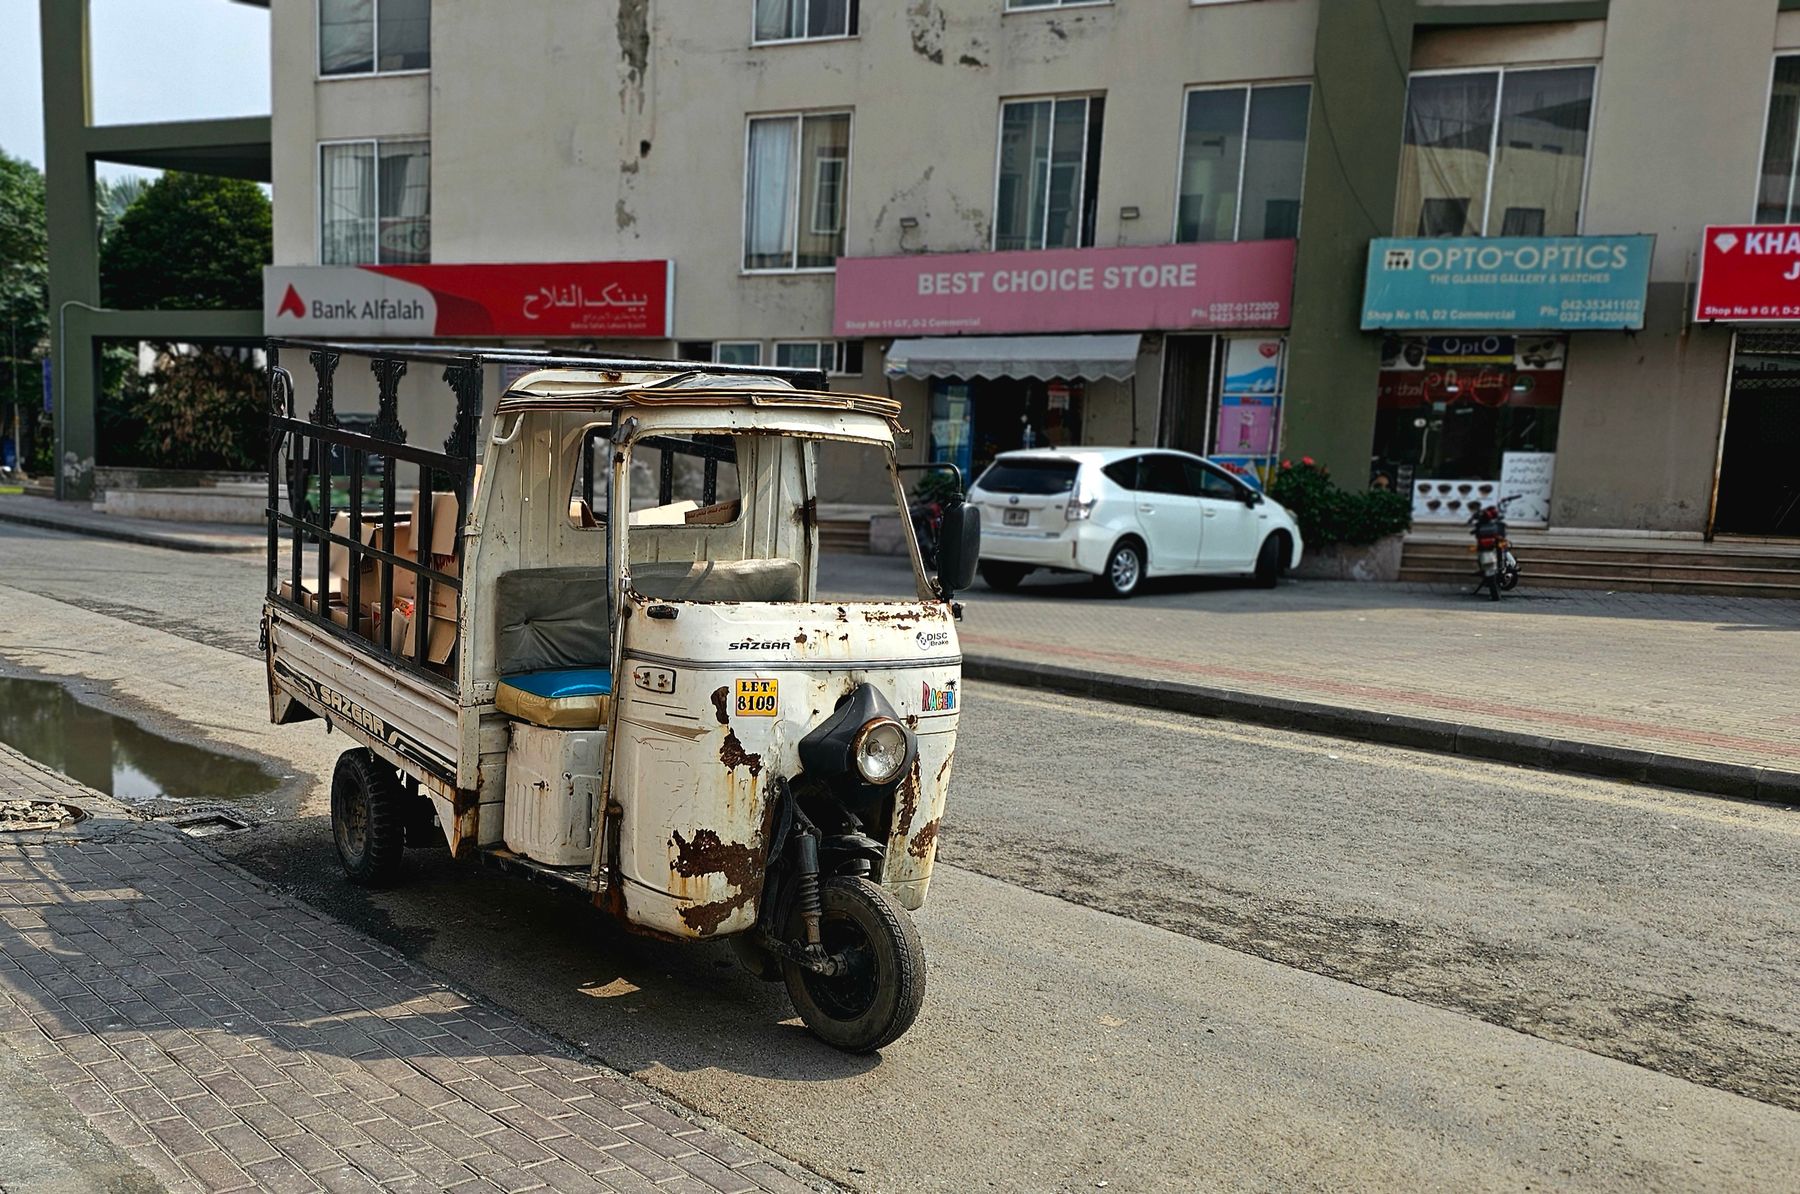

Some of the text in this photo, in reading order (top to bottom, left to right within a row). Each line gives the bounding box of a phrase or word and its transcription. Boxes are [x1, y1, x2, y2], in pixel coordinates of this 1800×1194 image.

[1418, 245, 1628, 270] OPTO-OPTICS
[918, 263, 1197, 295] BEST CHOICE STORE
[1430, 274, 1450, 284] THE
[1452, 273, 1498, 284] GLASSES
[1500, 273, 1546, 284] GALLERY
[1560, 272, 1610, 283] WATCHES
[312, 298, 425, 320] Bank Alfalah
[1704, 306, 1731, 316] Shop
[1733, 305, 1748, 315] No
[928, 317, 981, 327] Commercial
[1367, 310, 1393, 323] Shop
[1395, 309, 1411, 320] No
[1449, 309, 1516, 320] Commercial
[926, 632, 948, 641] DISC
[728, 641, 791, 650] SAZGAR
[930, 639, 949, 647] Brake
[741, 681, 770, 692] LET
[737, 695, 775, 711] 8109
[320, 686, 385, 739] SAZGAR
